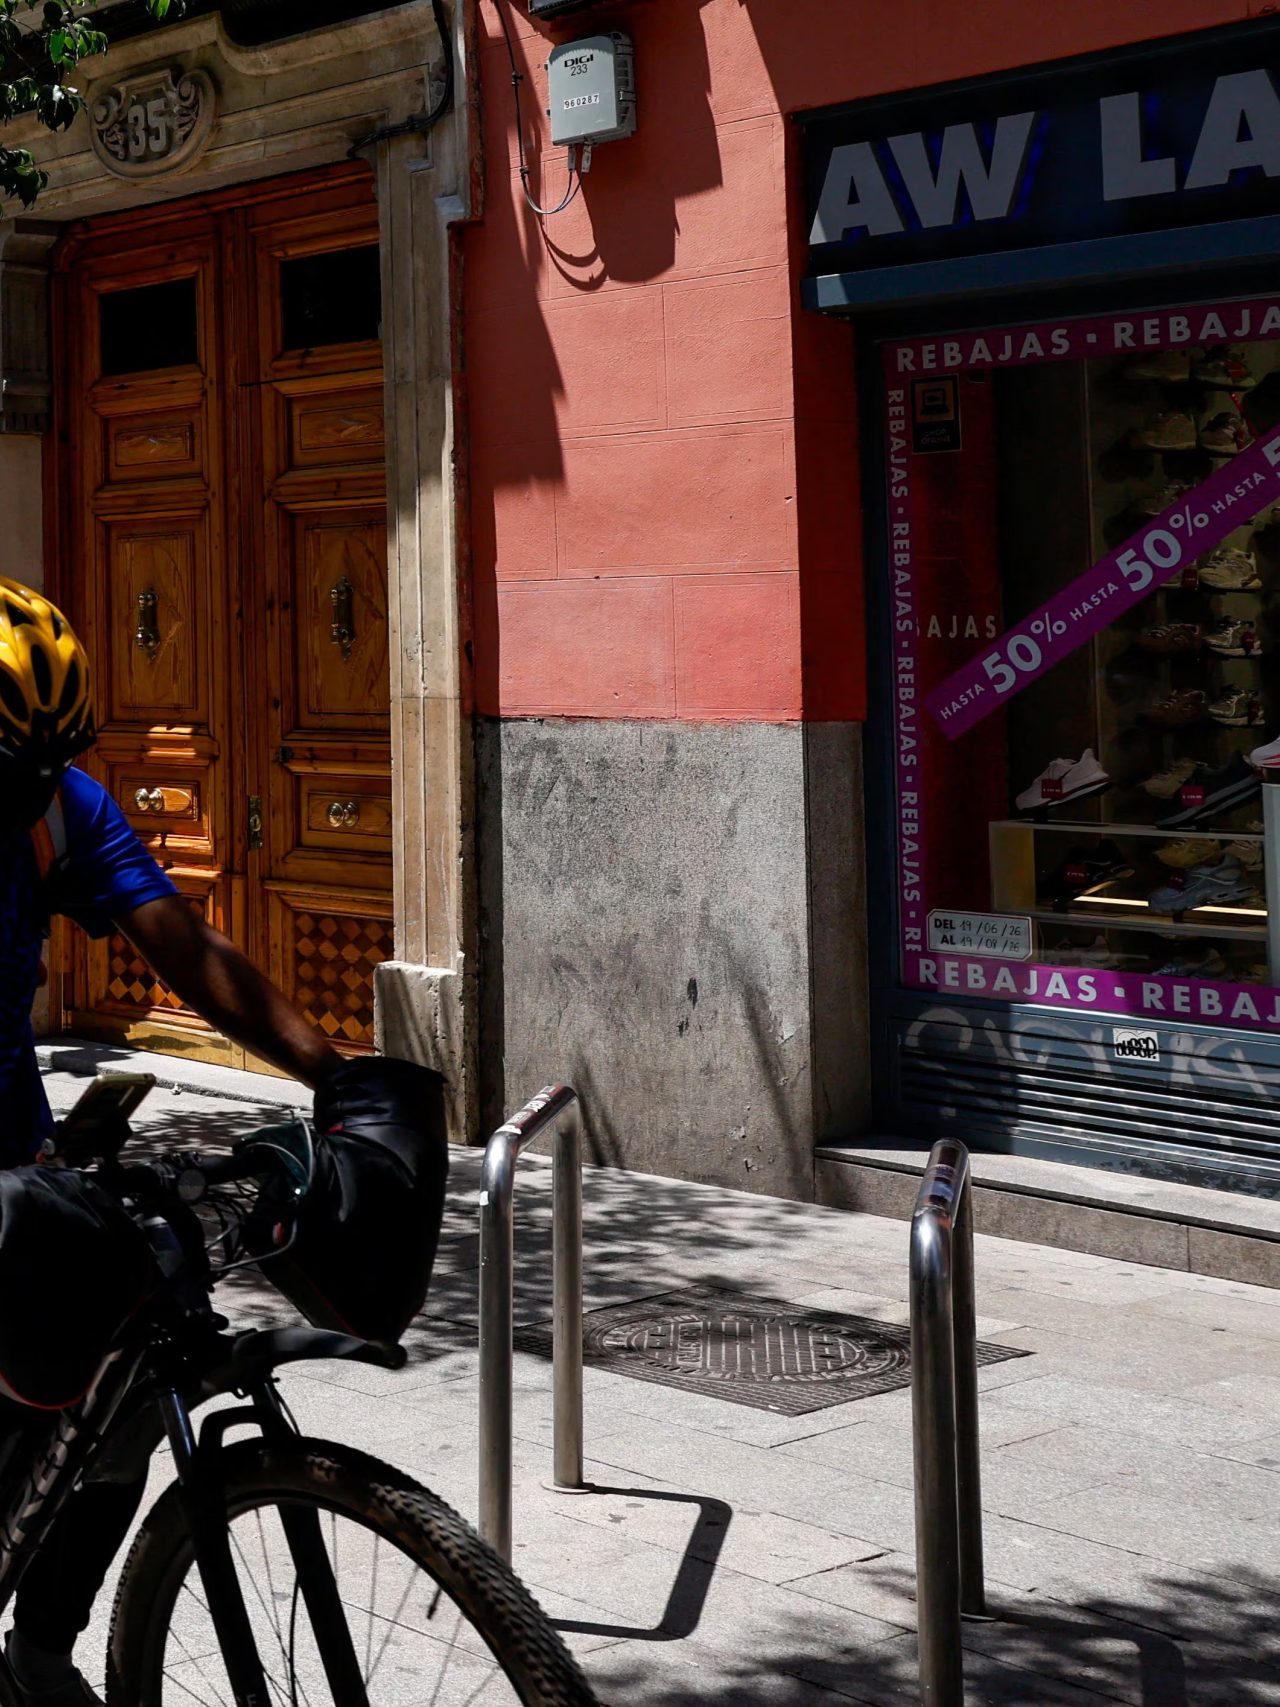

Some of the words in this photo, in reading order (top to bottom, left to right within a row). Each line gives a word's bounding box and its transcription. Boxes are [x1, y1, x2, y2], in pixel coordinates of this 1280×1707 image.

[564, 54, 594, 68] DIGI
[570, 64, 588, 76] 233
[127, 97, 167, 157] 35
[565, 95, 599, 109] 960287
[809, 111, 1036, 246] AW
[1100, 68, 1280, 201] LA
[896, 328, 1070, 372] REBAJAS
[1113, 305, 1280, 348] REBAJA
[888, 389, 908, 498] REBAJAS
[892, 523, 913, 632] REBAJAS
[939, 681, 984, 718] HASTA
[980, 611, 1065, 693] 50%
[1067, 581, 1117, 620] HASTA
[1115, 504, 1210, 592] 50%
[1211, 472, 1267, 514] HASTA
[897, 656, 917, 767] REBAJAS
[901, 791, 921, 902] REBAJAS
[934, 918, 956, 930] DEL
[940, 935, 956, 945] AL
[919, 958, 1097, 1002] REBAJAS
[1142, 981, 1280, 1024] REBAJ
